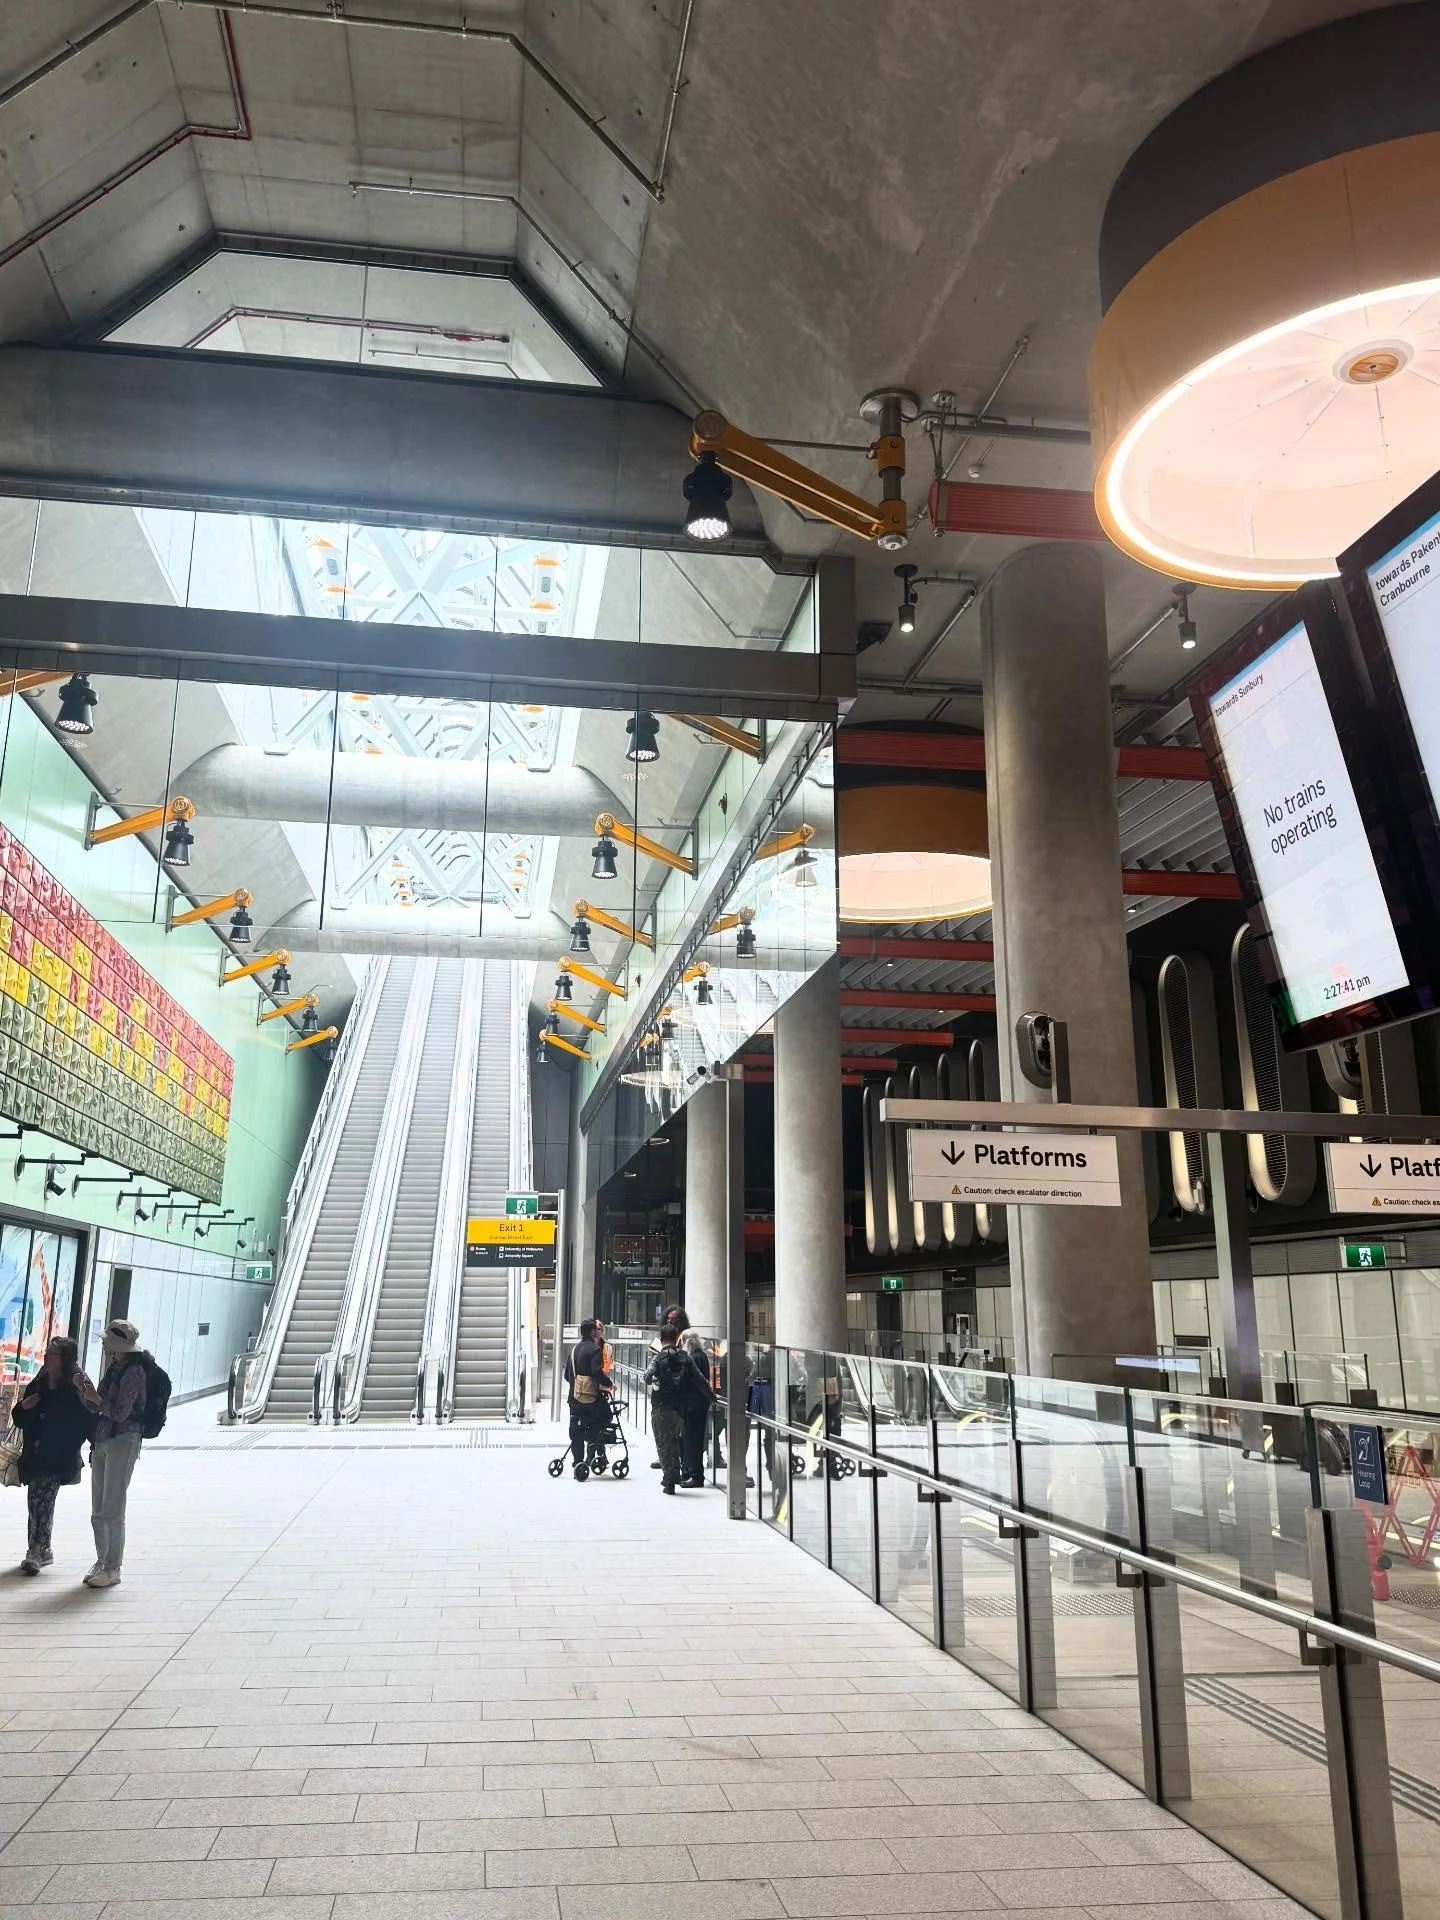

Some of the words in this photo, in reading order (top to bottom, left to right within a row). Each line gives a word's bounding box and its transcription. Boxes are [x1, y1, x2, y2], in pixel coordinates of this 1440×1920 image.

[1375, 557, 1411, 590] towards
[1380, 565, 1431, 607] Cranbourne
[1215, 694, 1239, 717] towards
[1238, 674, 1264, 698] Sunbury
[1263, 804, 1283, 828] No
[1284, 779, 1326, 815] trains
[1271, 803, 1337, 856] operating
[1323, 978, 1356, 1000] 2:27:41
[1356, 975, 1371, 992] pm
[973, 1144, 1087, 1168] Platforms
[963, 1186, 993, 1195] Caution:
[994, 1187, 1016, 1196] check
[1016, 1188, 1049, 1197] escalator
[1050, 1189, 1082, 1198] direction
[1383, 1197, 1411, 1206] Caution:
[1411, 1197, 1431, 1206] check
[499, 1223, 517, 1232] Exit
[519, 1224, 524, 1232] 1
[1357, 1467, 1376, 1482] Hearing
[1358, 1479, 1371, 1490] Loop
